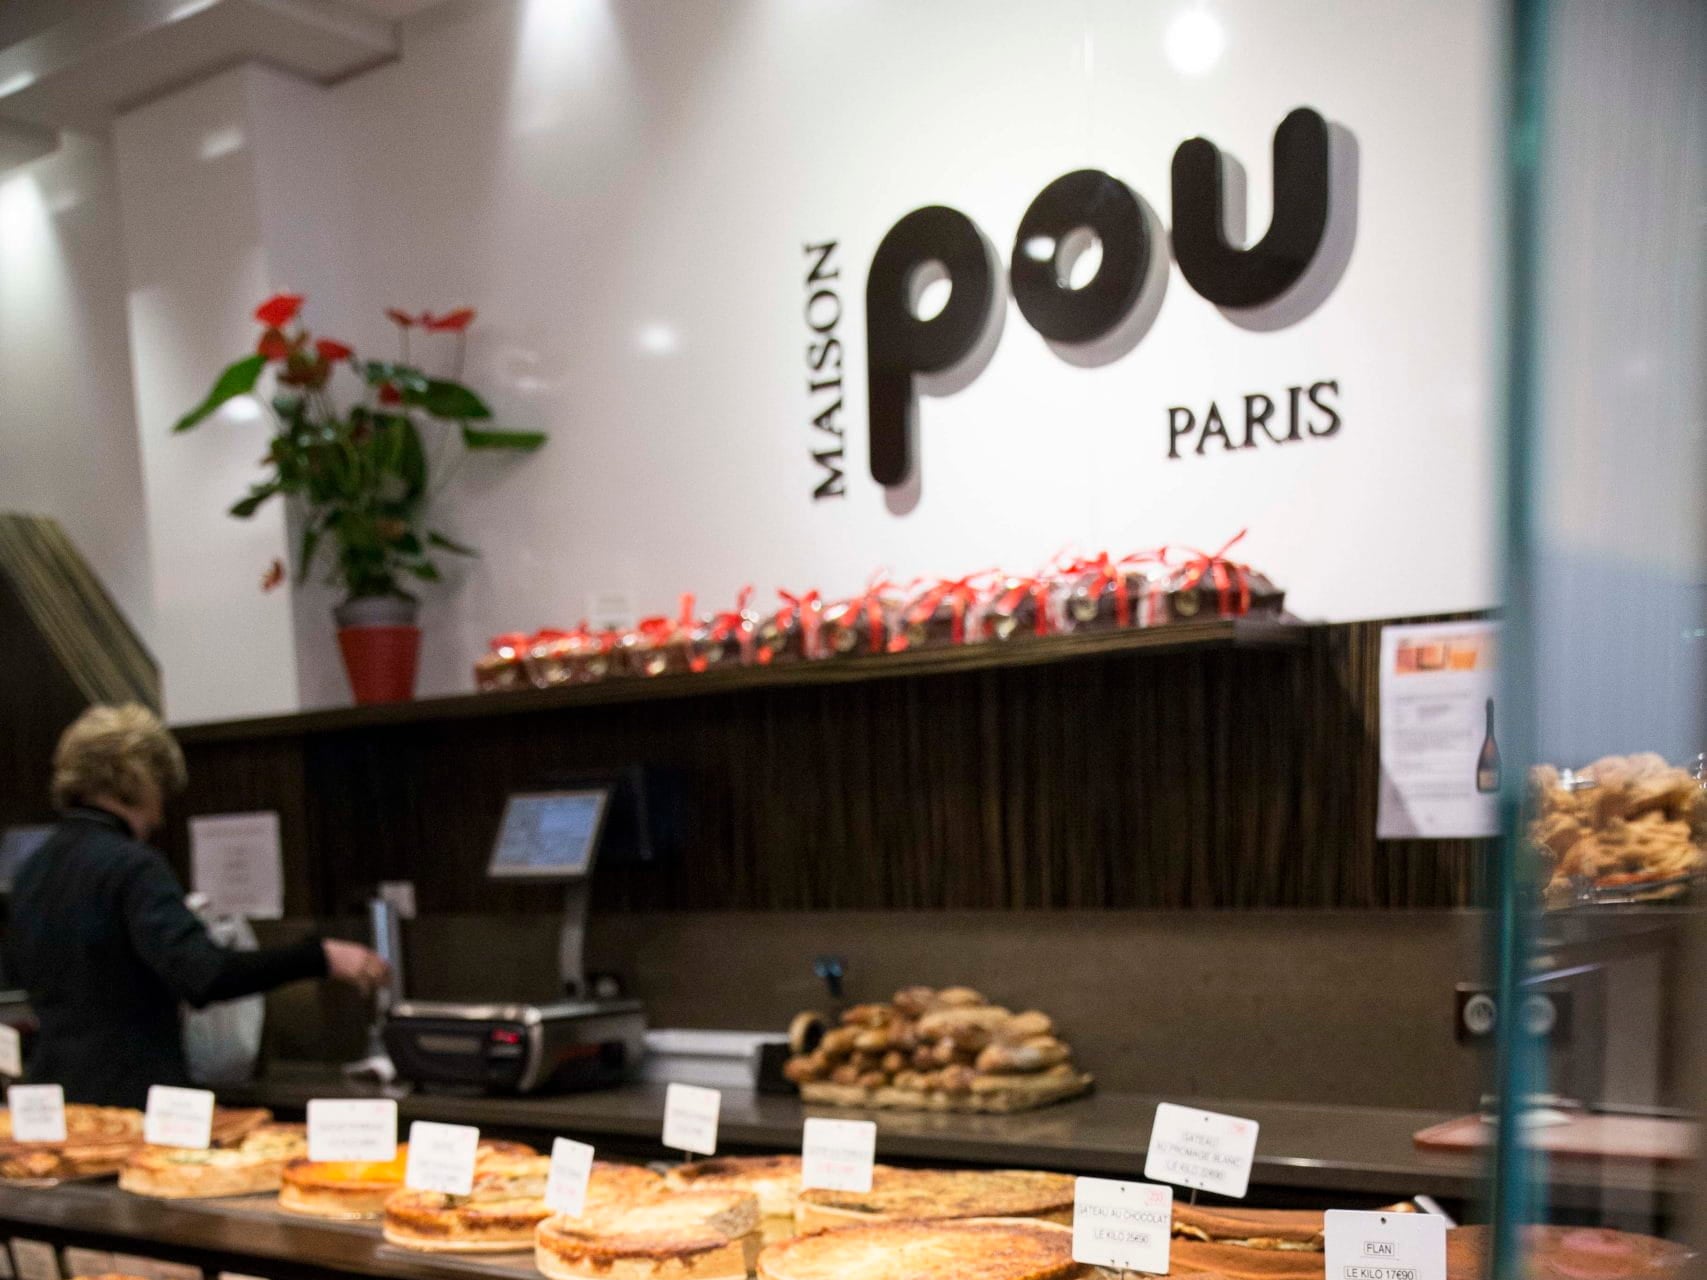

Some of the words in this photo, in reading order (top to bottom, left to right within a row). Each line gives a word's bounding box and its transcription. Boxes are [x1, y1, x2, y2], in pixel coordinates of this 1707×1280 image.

[803, 239, 845, 502] MAISON
[1167, 380, 1341, 458] PARIS
[1110, 1208, 1122, 1218] AU
[1123, 1209, 1168, 1224] CHOCOLAT
[1094, 1228, 1105, 1240] LE
[1106, 1231, 1125, 1242] KILO
[1366, 1243, 1392, 1255] FLAN
[1346, 1268, 1358, 1278] LE
[1360, 1268, 1383, 1280] KILO
[1386, 1270, 1414, 1280] 17€90
